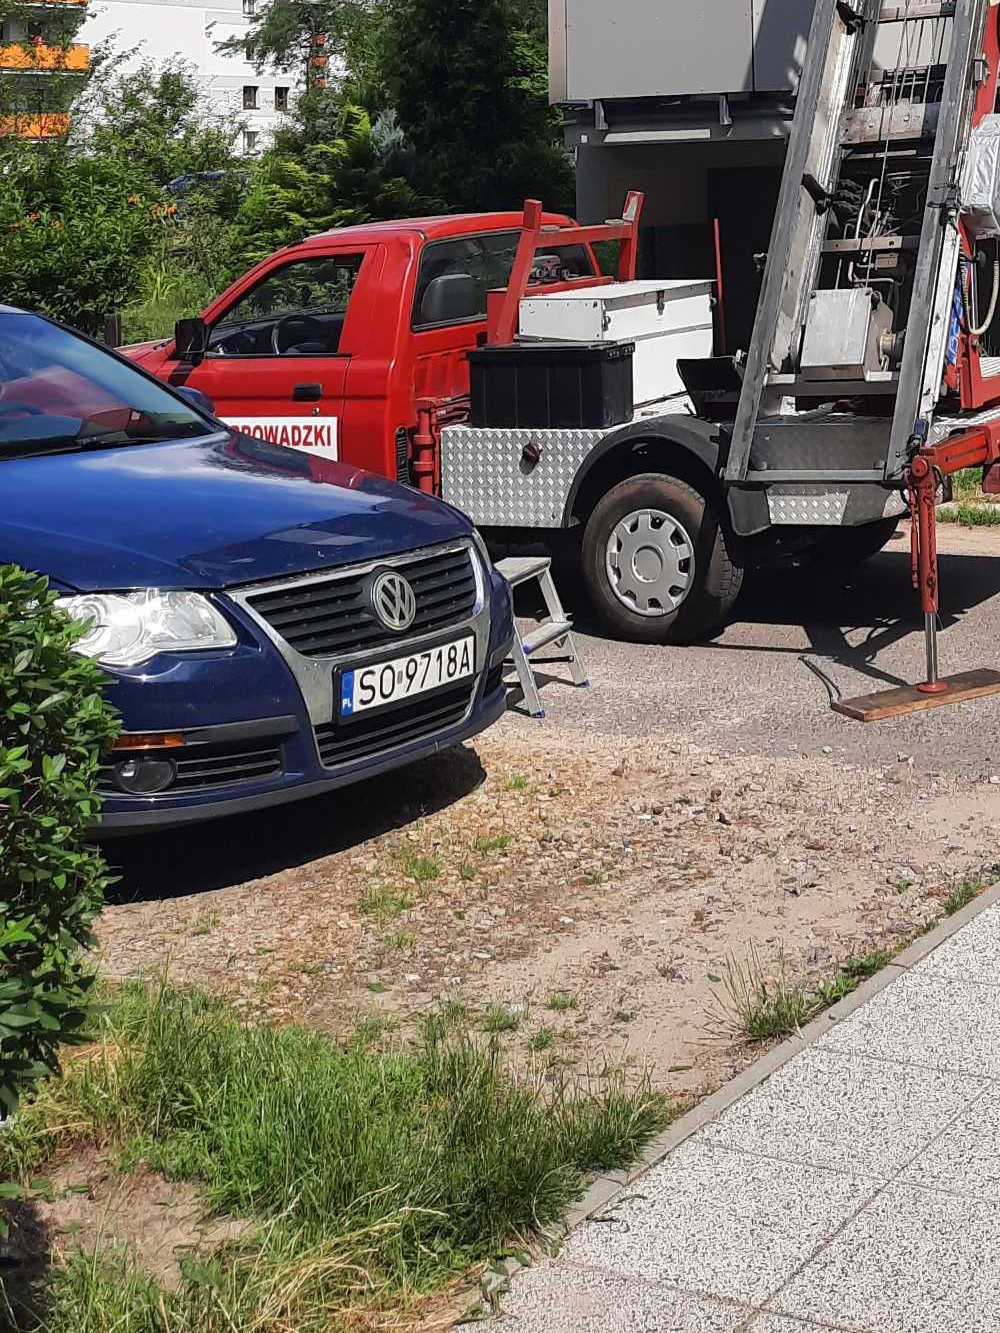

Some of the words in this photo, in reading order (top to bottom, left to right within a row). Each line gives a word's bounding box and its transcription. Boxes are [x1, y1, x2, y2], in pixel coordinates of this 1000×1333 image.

[342, 697, 352, 710] PL
[359, 664, 396, 706] SO
[404, 641, 471, 693] 9718A
